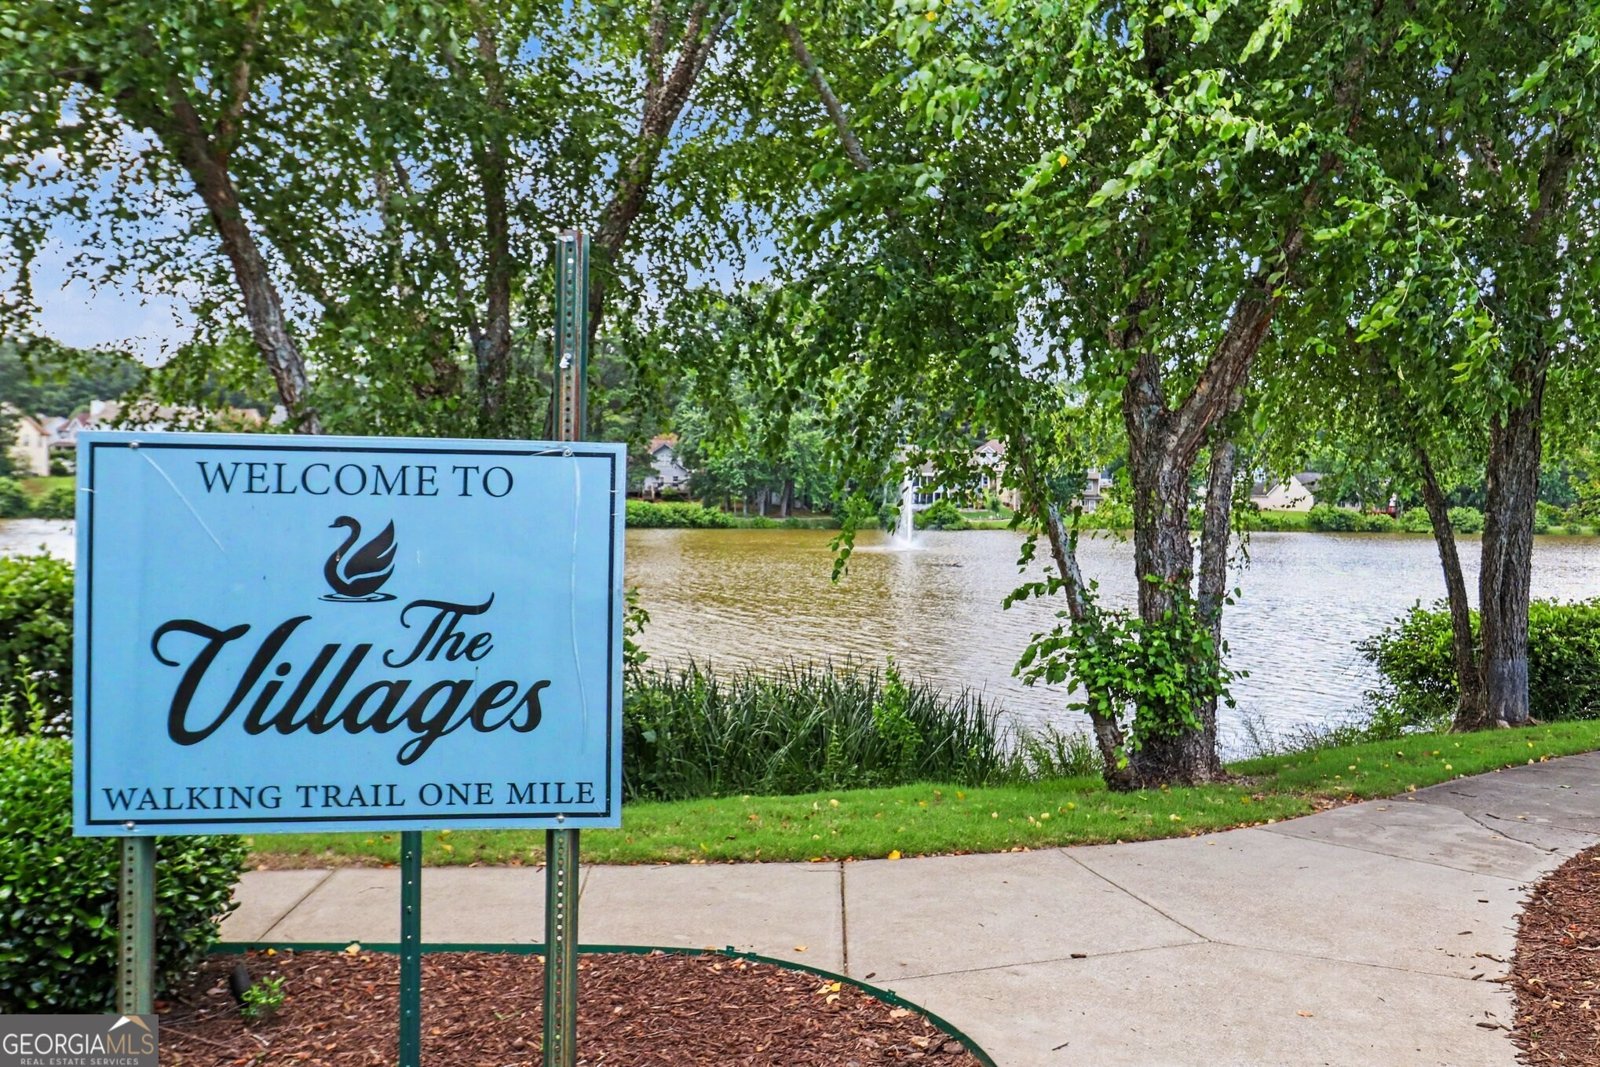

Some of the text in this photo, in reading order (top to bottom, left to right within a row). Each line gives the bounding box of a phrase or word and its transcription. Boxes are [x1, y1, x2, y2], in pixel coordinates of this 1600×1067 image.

[195, 461, 514, 498] WELCOME TO
[382, 591, 495, 669] The
[150, 614, 552, 767] Villages
[101, 781, 596, 811] WALKING TRAIL ONE MILE
